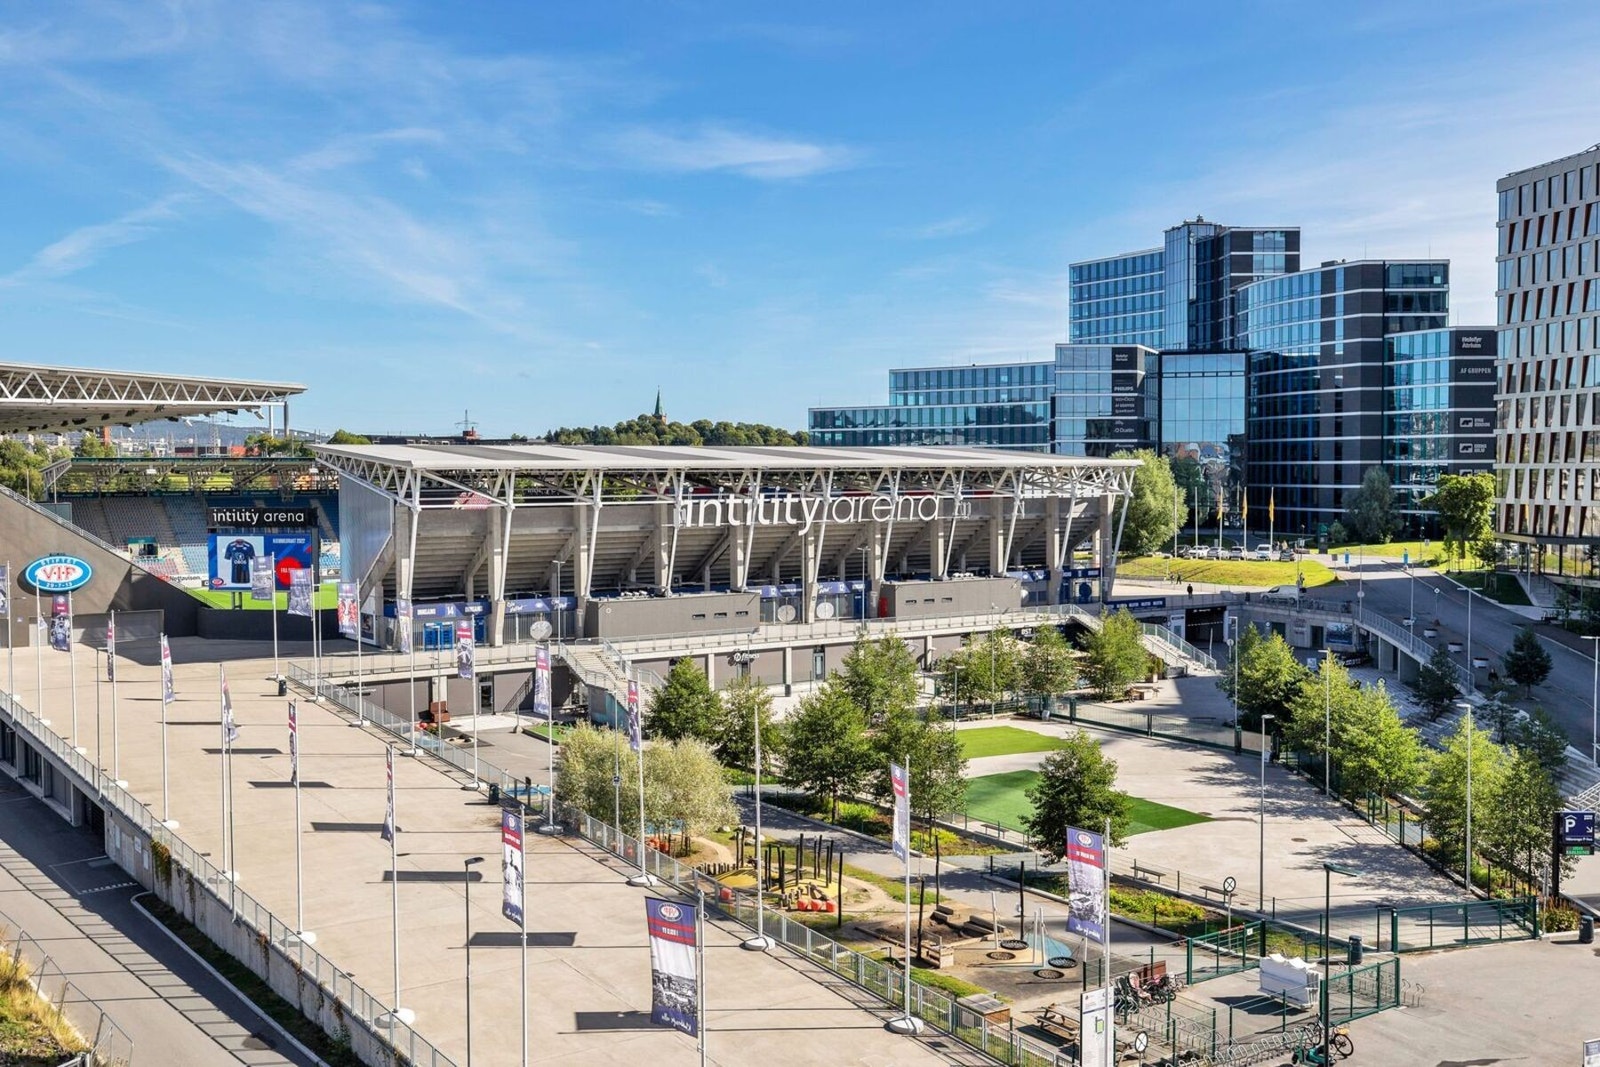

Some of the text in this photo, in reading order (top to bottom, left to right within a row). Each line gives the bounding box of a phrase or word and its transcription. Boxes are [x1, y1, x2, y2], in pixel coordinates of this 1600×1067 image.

[213, 509, 305, 525] intility arena
[680, 486, 940, 536] intility arena
[1565, 819, 1576, 832] P
